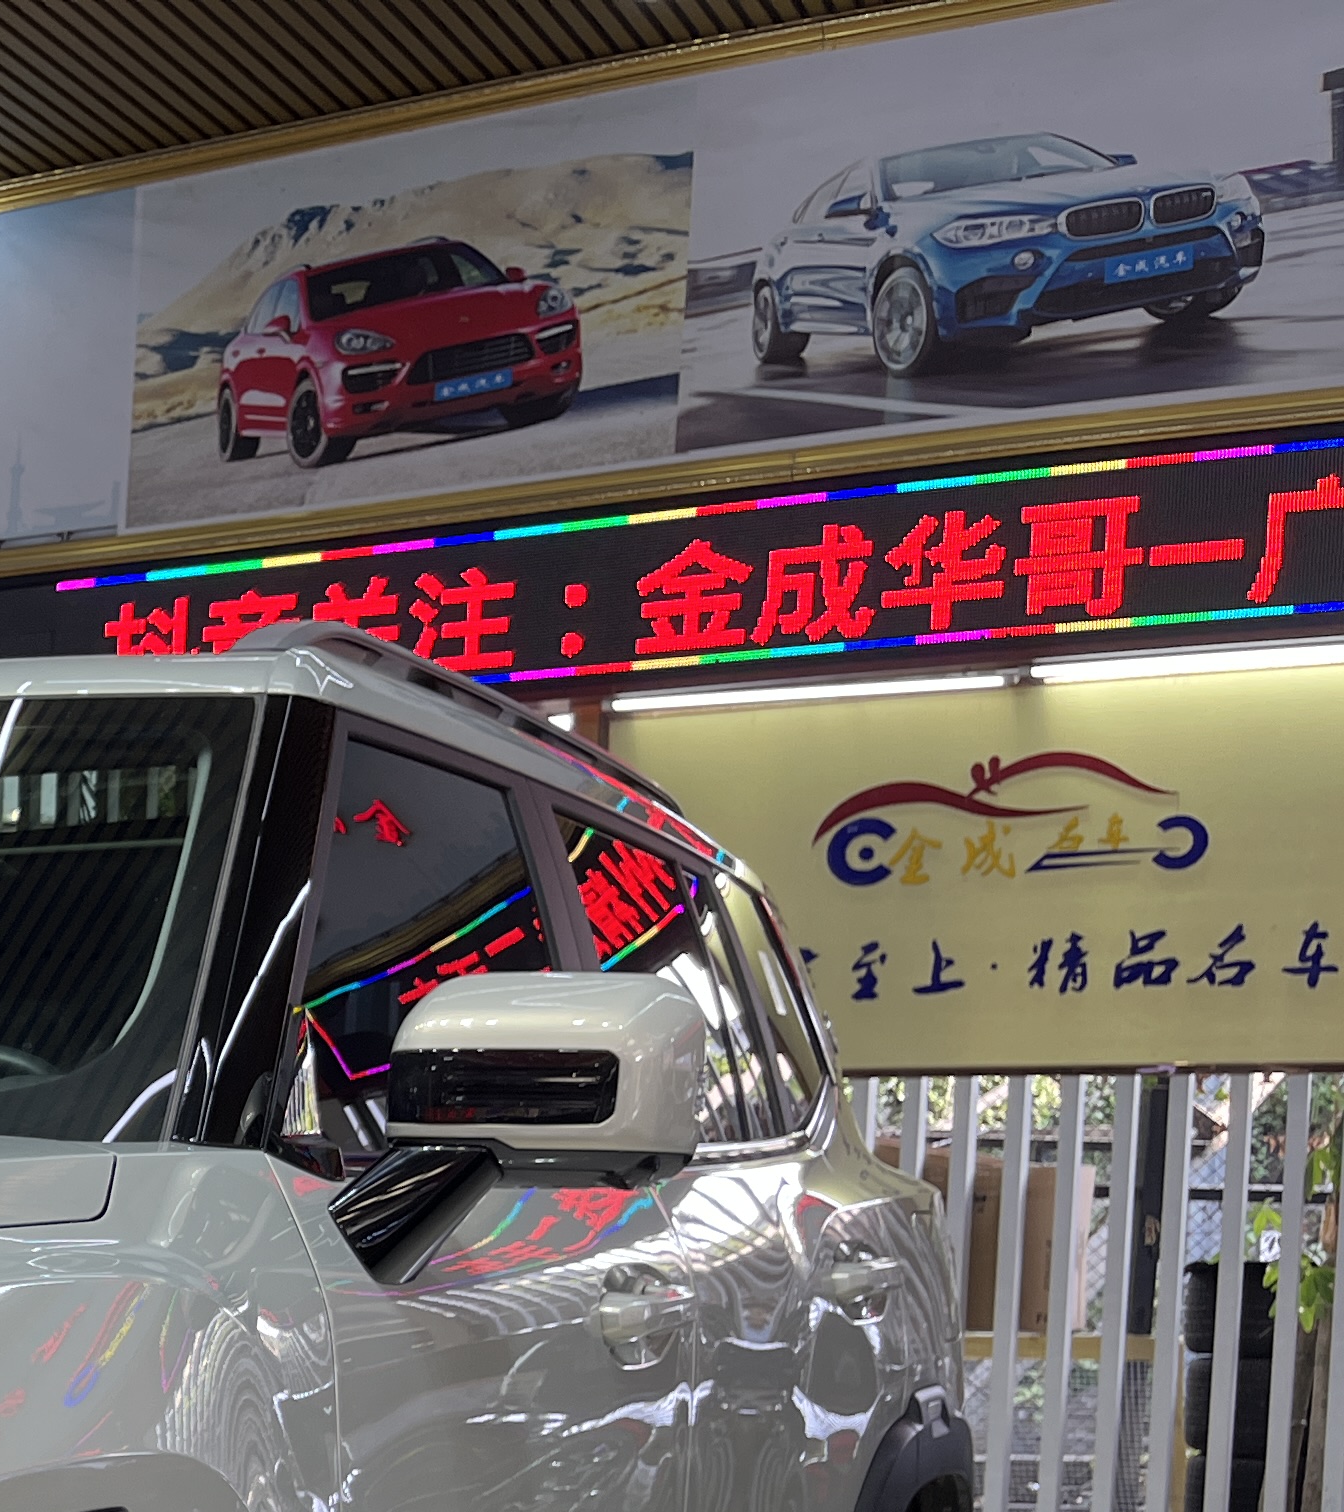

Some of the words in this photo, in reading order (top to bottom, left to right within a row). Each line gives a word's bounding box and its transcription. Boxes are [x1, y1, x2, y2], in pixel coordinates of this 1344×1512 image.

[800, 920, 1340, 1001] 至上·精品名车
